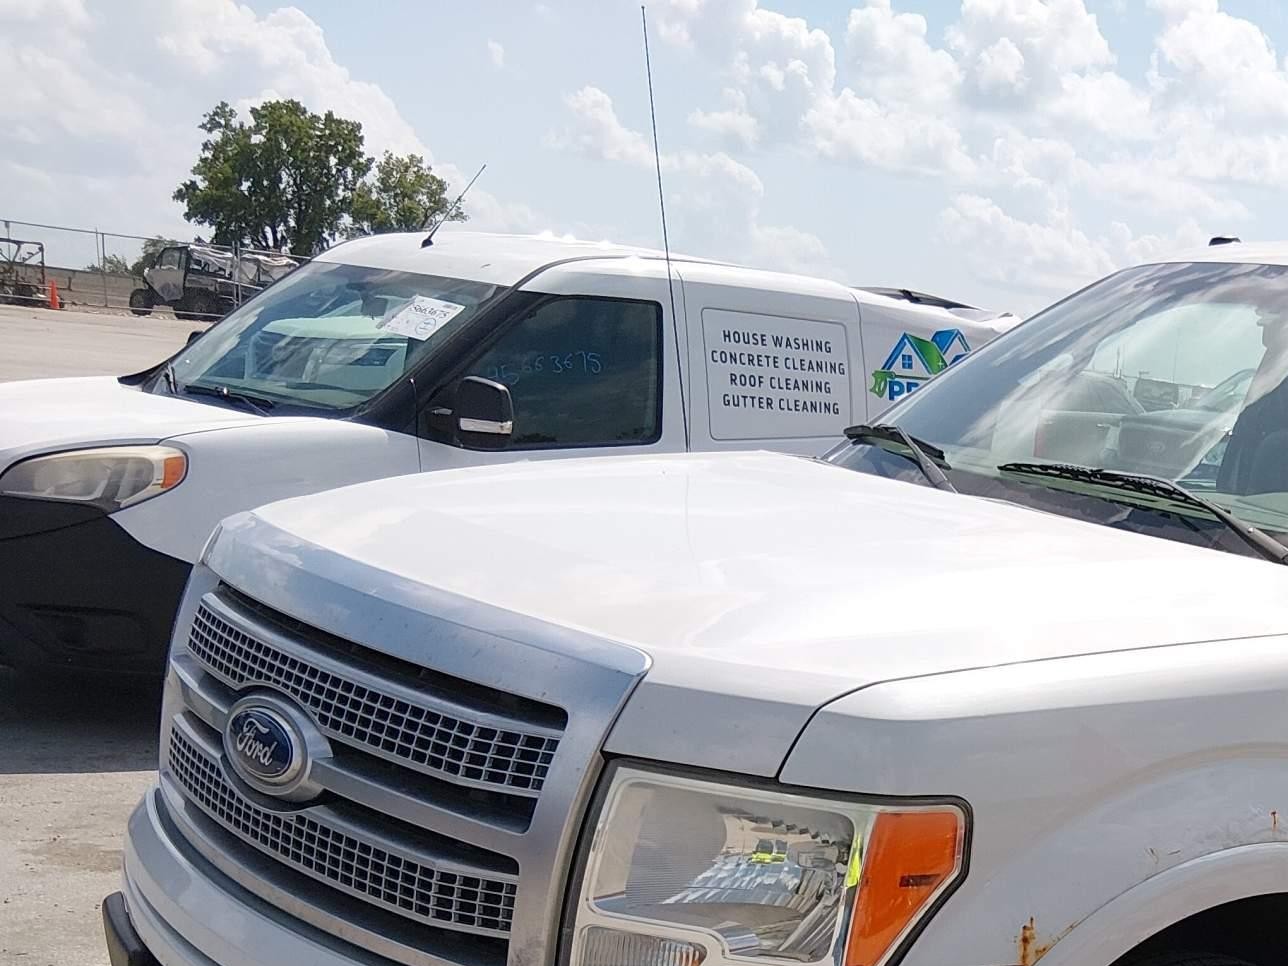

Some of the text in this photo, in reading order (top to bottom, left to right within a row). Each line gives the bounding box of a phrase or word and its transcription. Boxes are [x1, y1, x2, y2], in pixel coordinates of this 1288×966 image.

[722, 329, 832, 354] HOUSE WASHING
[711, 349, 846, 376] CONCRETE CLEANING
[729, 372, 832, 394] ROOF CLEANING
[722, 393, 840, 415] GUTTER CLEANING
[237, 717, 278, 767] Ford
